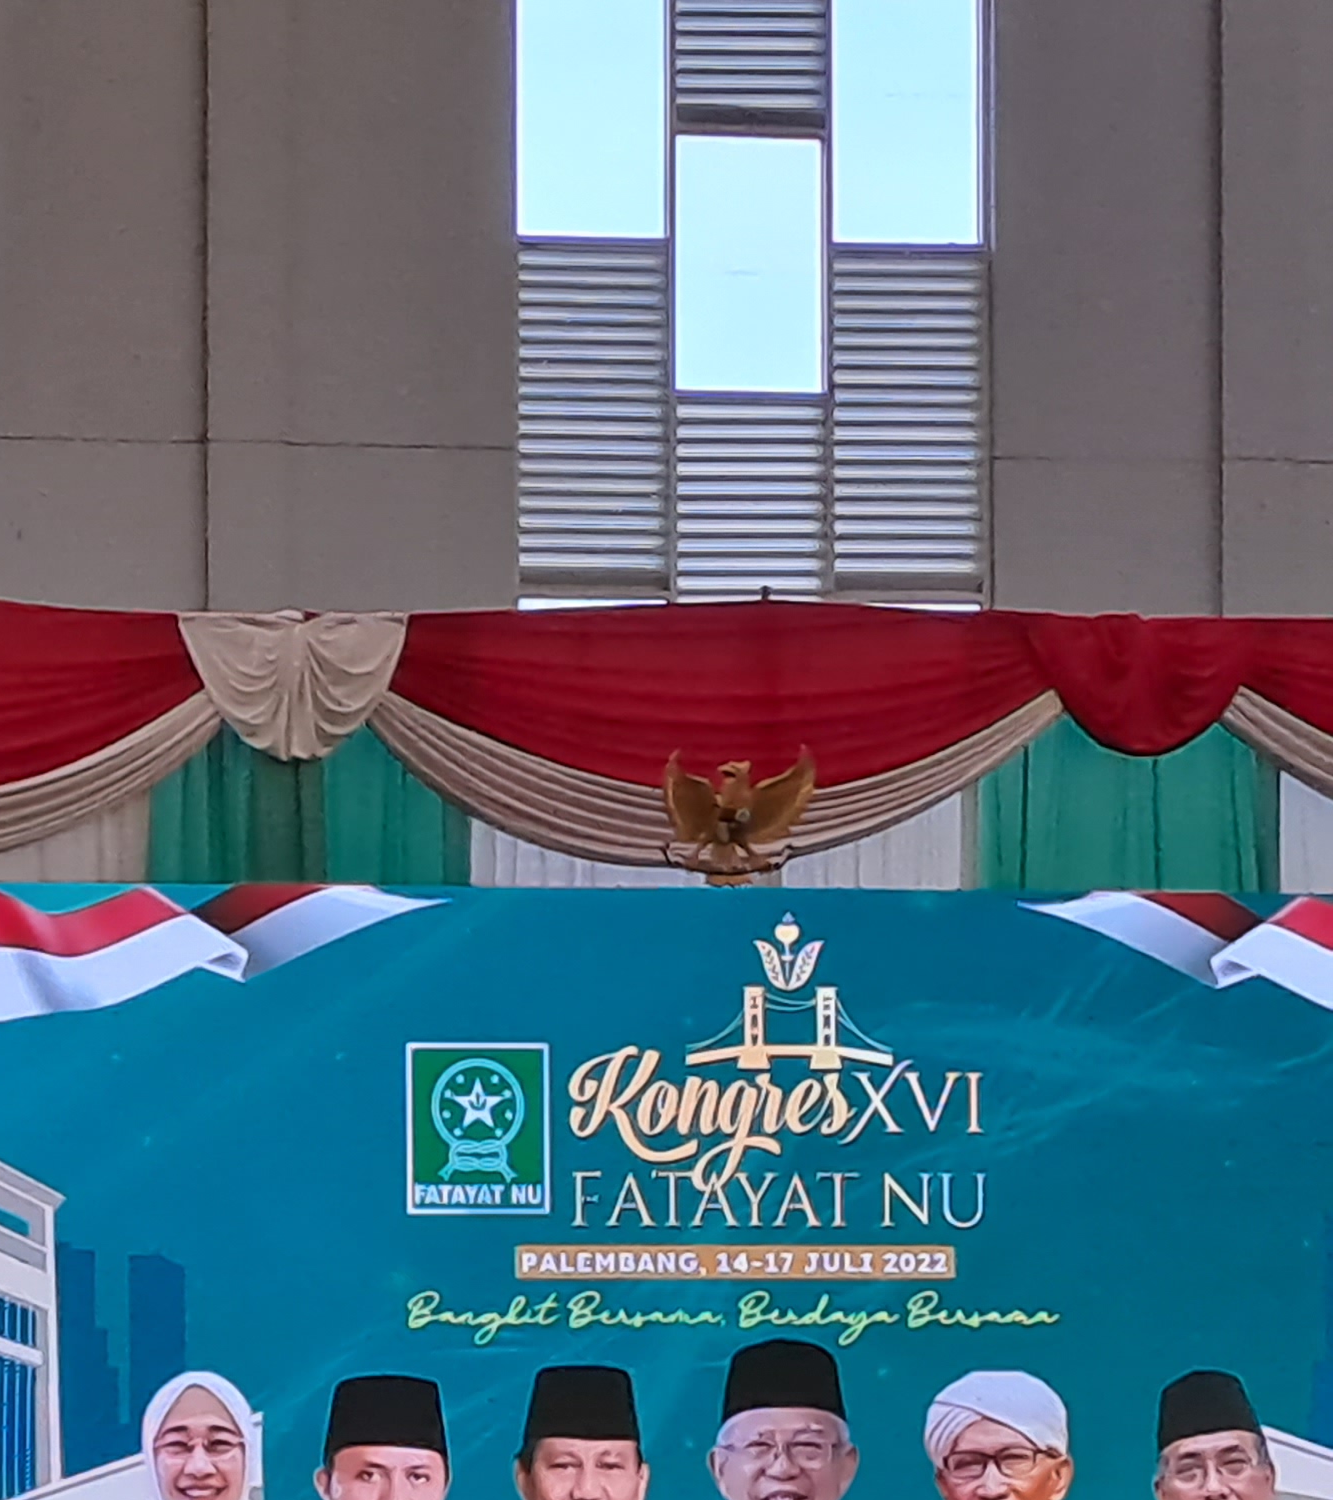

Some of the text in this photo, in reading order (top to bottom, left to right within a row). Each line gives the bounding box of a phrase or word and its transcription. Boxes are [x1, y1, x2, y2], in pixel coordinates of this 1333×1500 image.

[568, 1046, 985, 1192] Kongres XVI
[414, 1184, 543, 1205] FATAYAT NU
[571, 1171, 986, 1229] FATAYAT NU
[521, 1252, 948, 1277] PALEMBANG, 14-17 JULI 2022
